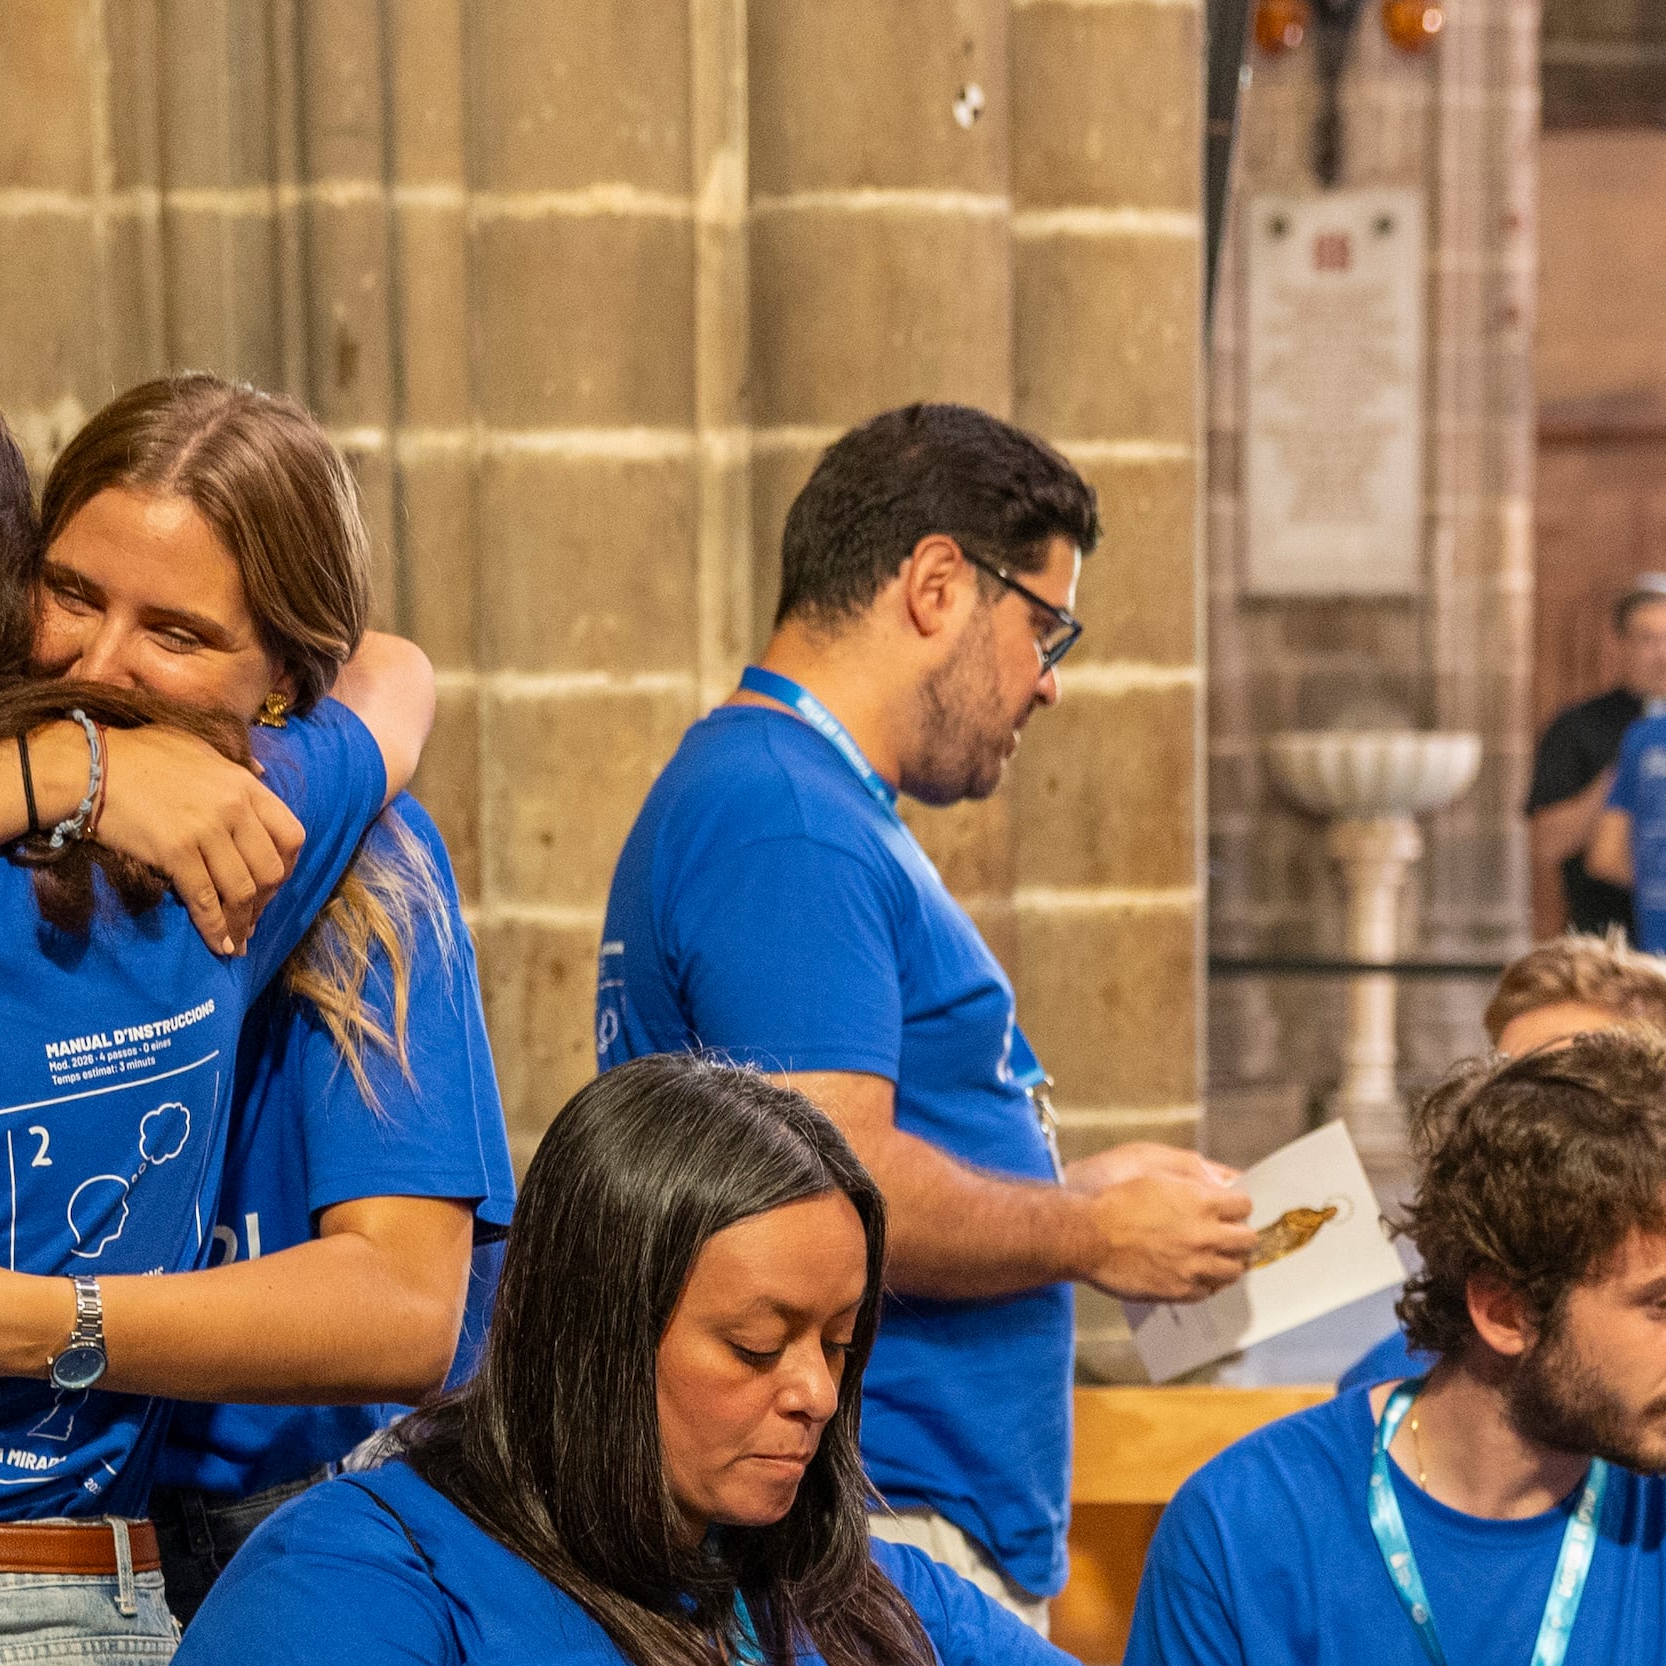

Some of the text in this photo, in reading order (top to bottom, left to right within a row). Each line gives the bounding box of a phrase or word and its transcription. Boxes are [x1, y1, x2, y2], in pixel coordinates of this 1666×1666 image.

[45, 998, 215, 1058] MANUAL D'INSTRUCCIONS
[49, 1061, 71, 1072] Mod.
[72, 1055, 93, 1068] 2026
[99, 1053, 106, 1063] 4
[107, 1046, 137, 1063] passos
[151, 1038, 171, 1051] eines
[52, 1056, 155, 1086] Temps estimat: 3 minuts
[28, 1126, 52, 1167] 2
[6, 1449, 67, 1470] MIRAD
